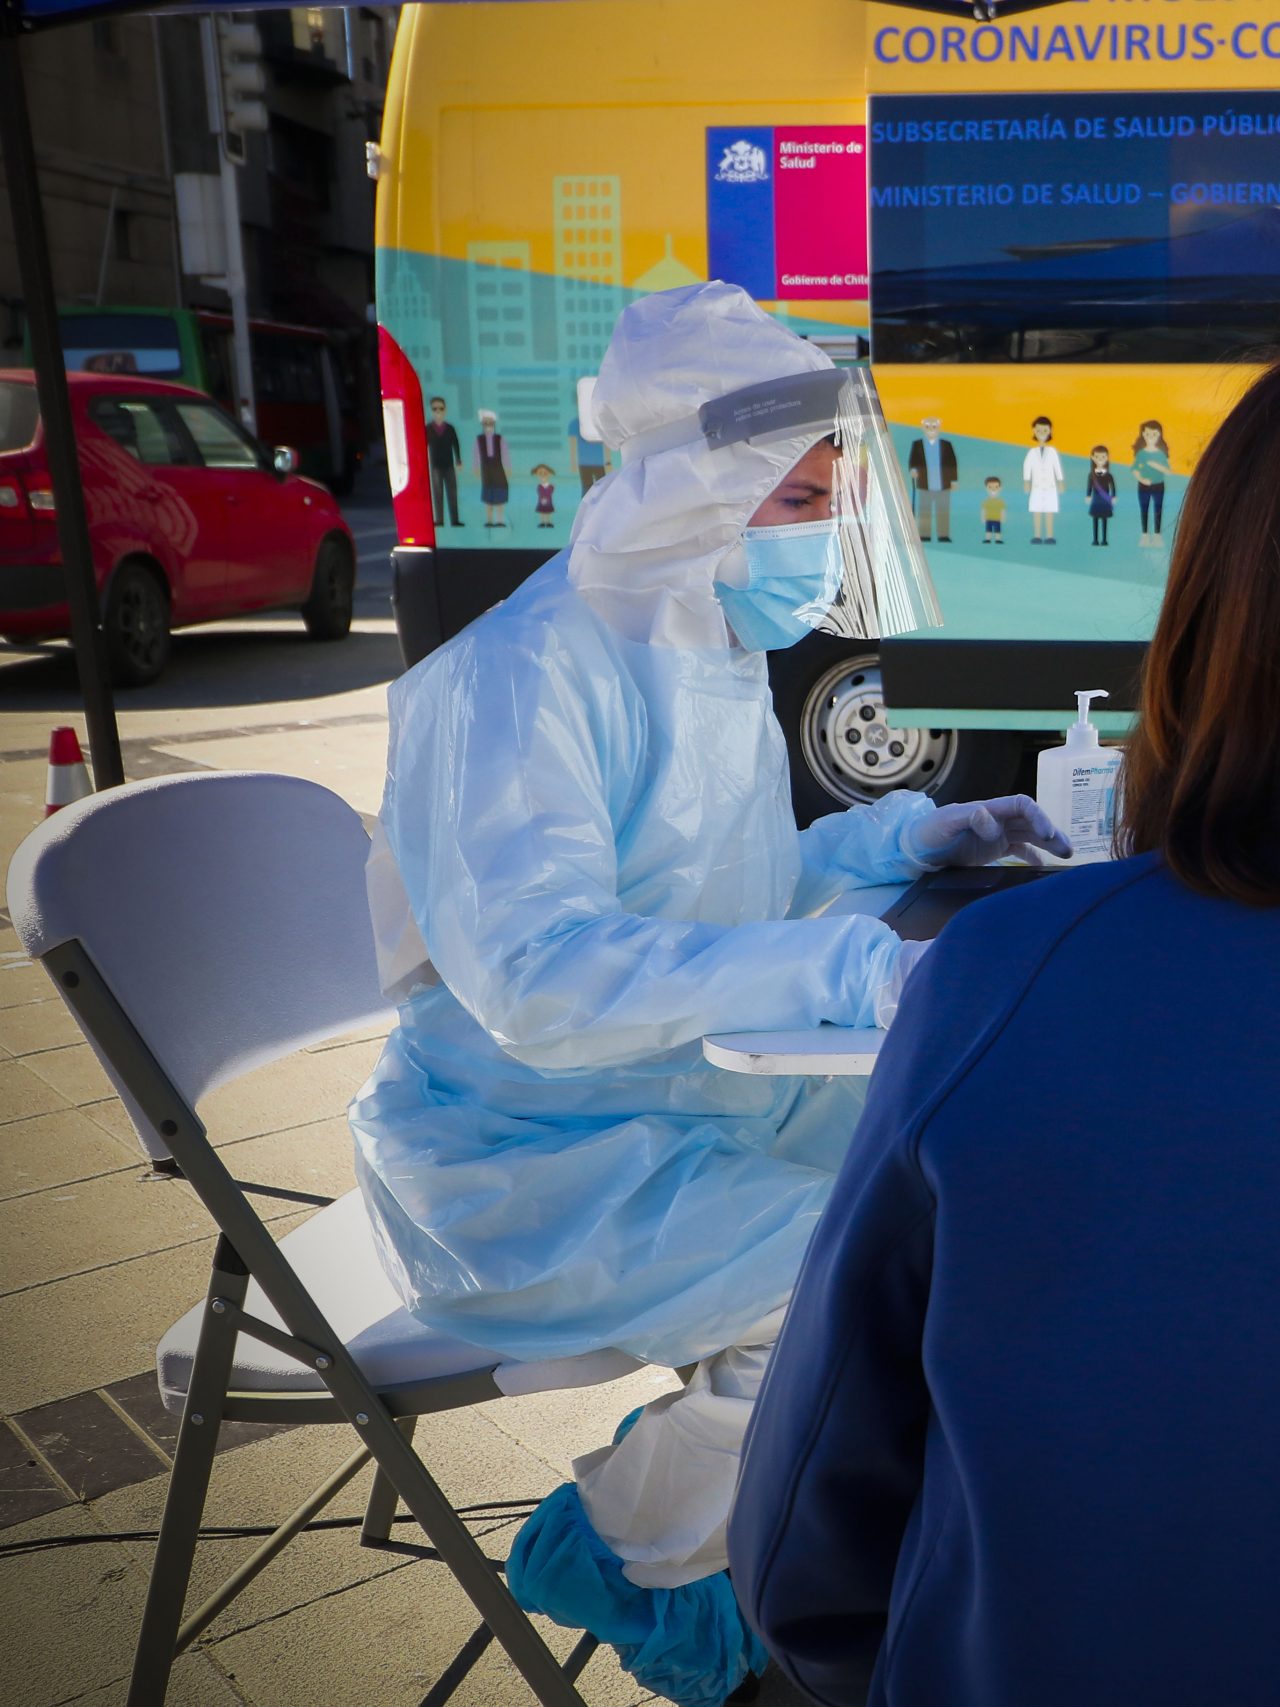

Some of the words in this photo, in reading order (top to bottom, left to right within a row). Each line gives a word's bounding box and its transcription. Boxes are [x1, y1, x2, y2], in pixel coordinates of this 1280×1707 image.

[871, 113, 1067, 143] SUBSECRETARÍA
[1074, 117, 1107, 139] DE
[1113, 116, 1195, 138] SALUD
[779, 141, 844, 154] Ministerio
[846, 141, 863, 154] de
[779, 156, 816, 169] Salud
[869, 184, 1014, 208] MINISTERIO
[1022, 183, 1053, 204] DE
[1060, 183, 1141, 205] SALUD
[781, 274, 828, 286] Gobierno
[829, 274, 842, 285] de
